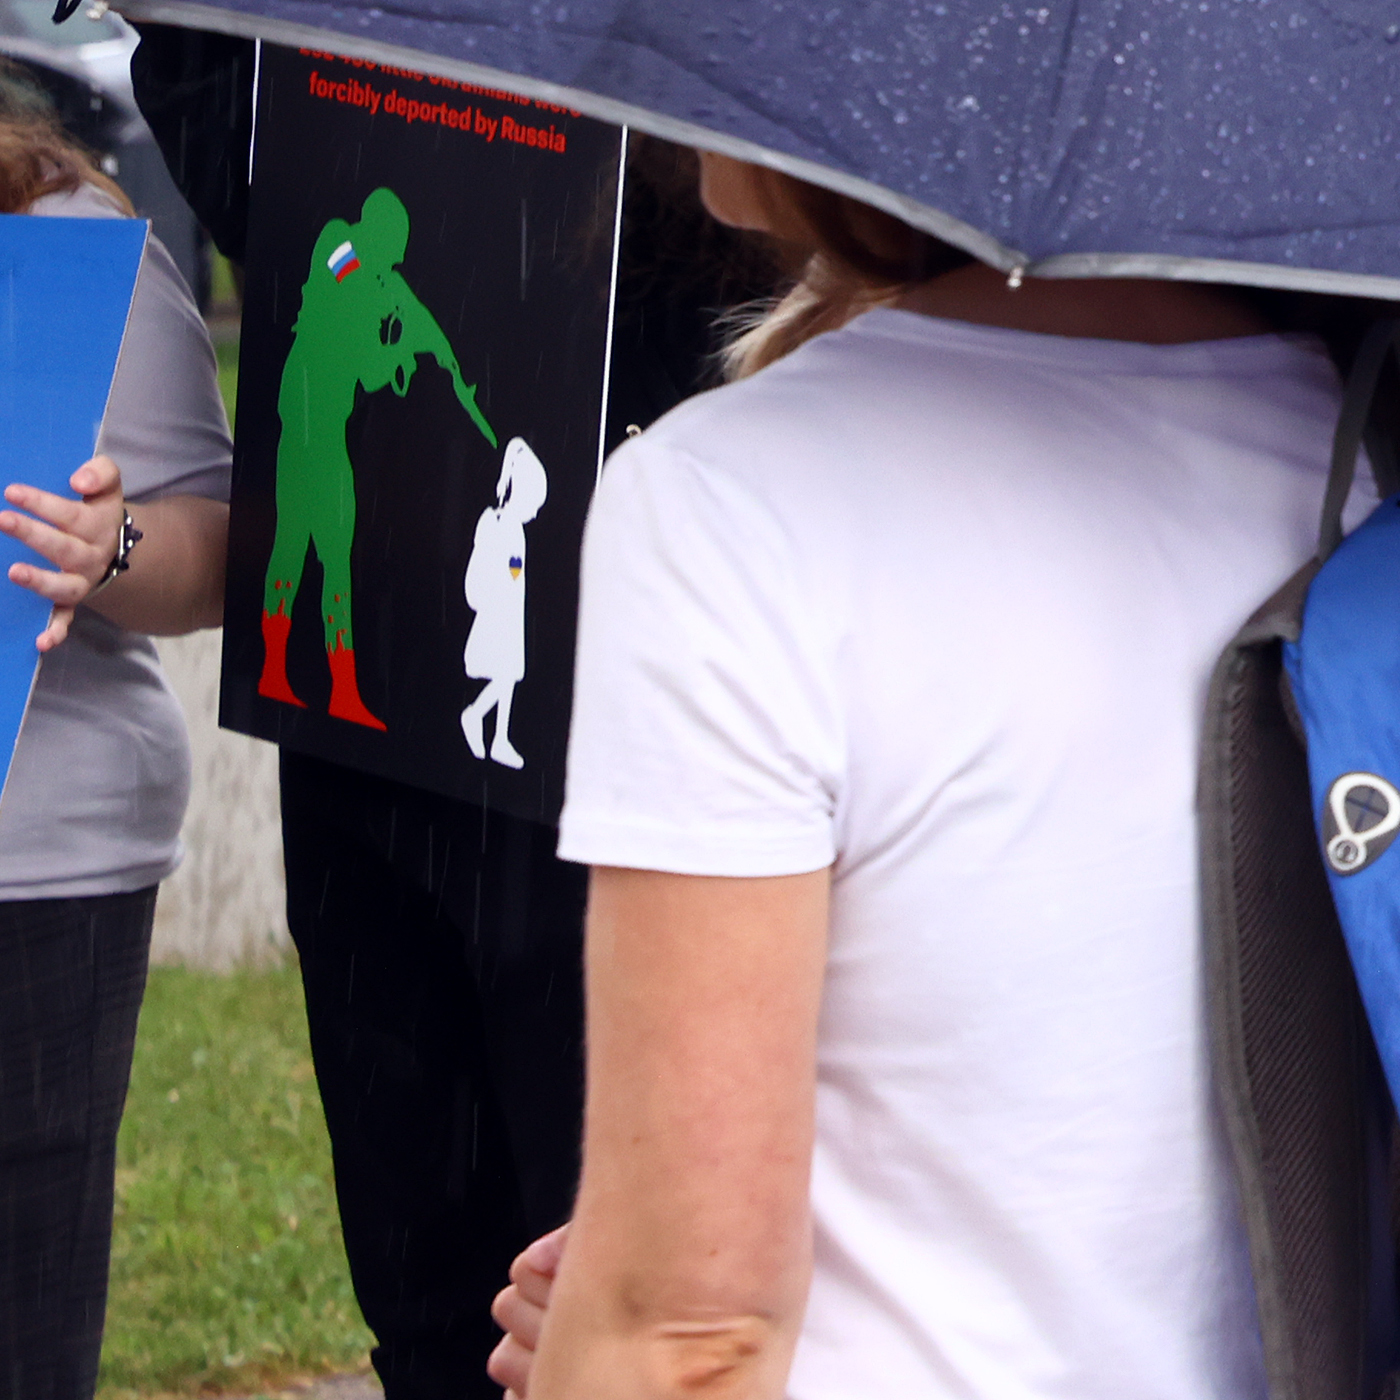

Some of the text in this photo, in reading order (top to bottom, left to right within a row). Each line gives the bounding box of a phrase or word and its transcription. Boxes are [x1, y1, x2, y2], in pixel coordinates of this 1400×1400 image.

[308, 71, 382, 116] forcibly
[383, 89, 473, 131] deported
[474, 108, 499, 142] by
[500, 115, 567, 154] Russia
